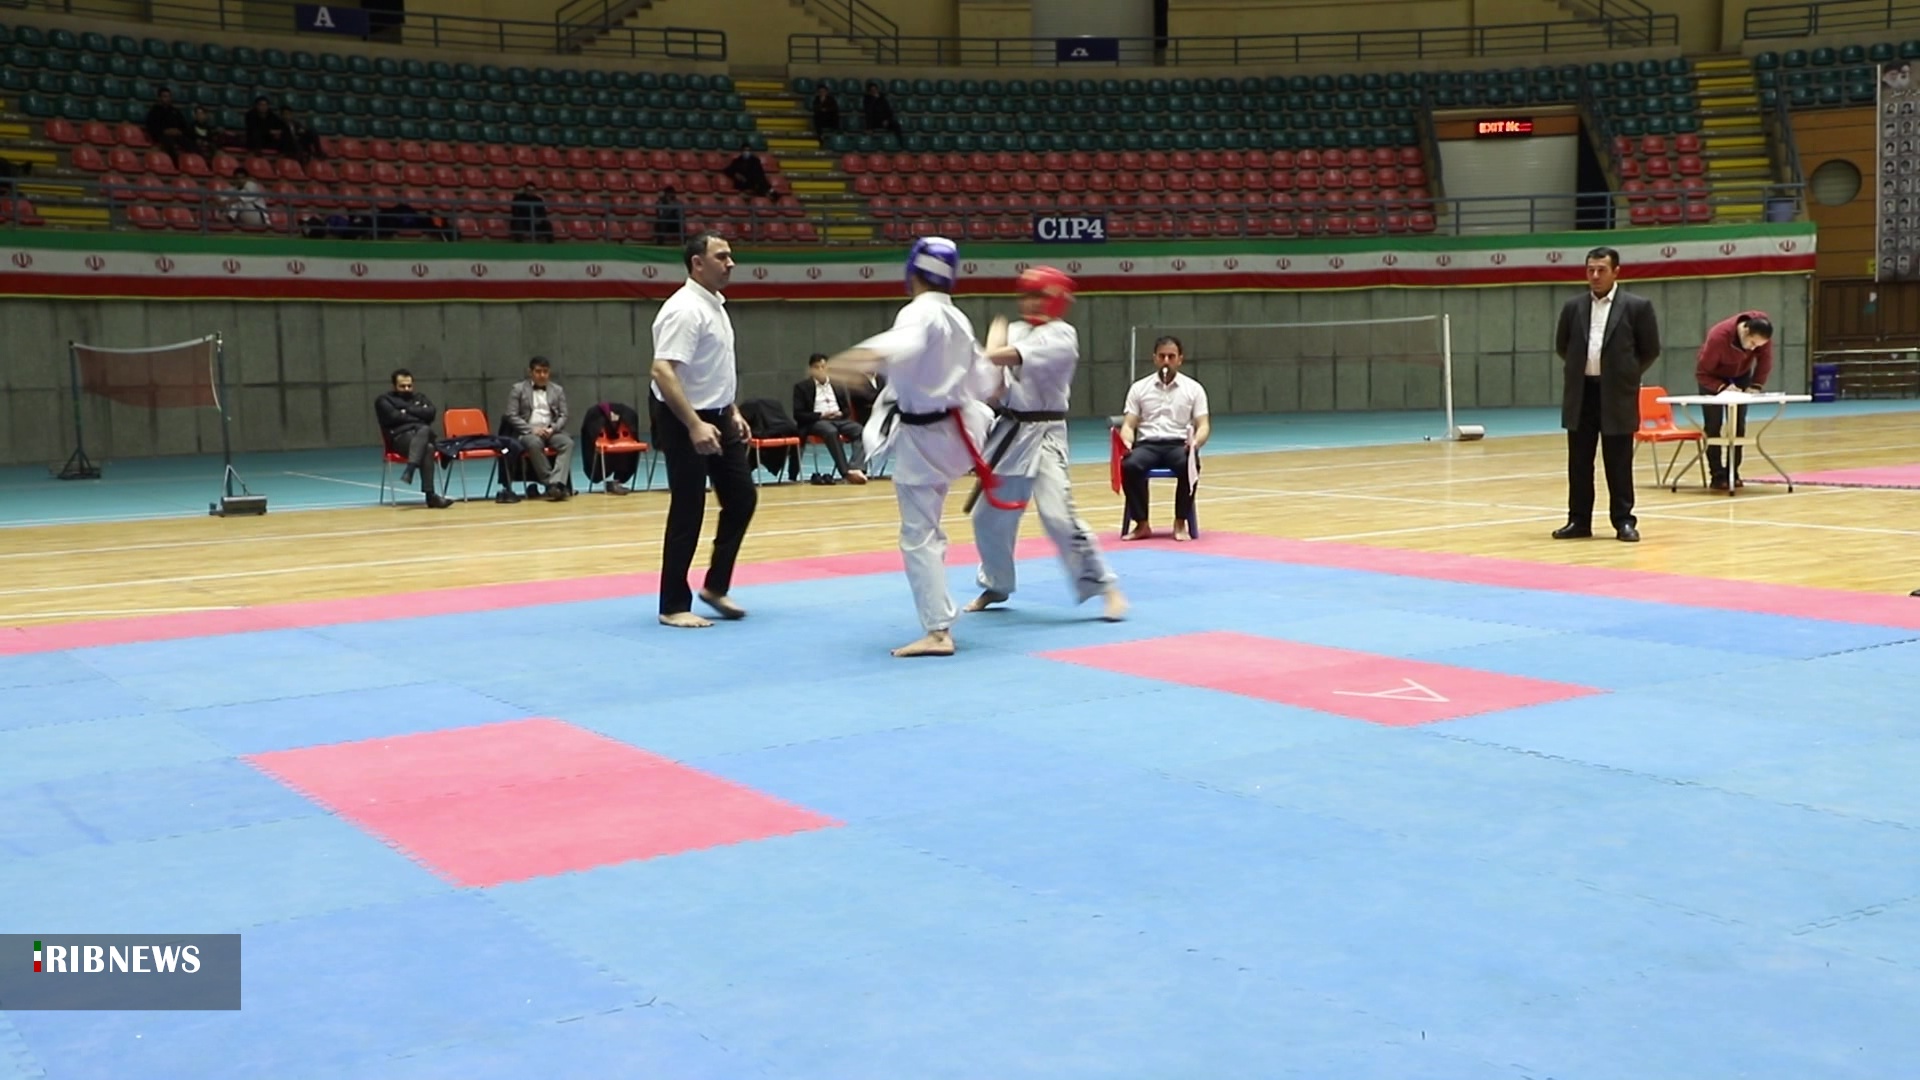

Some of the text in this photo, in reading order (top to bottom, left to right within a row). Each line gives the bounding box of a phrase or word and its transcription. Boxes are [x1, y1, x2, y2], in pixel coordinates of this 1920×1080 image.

[313, 6, 336, 28] A
[1037, 217, 1105, 240] CIP4
[1332, 677, 1450, 702] A
